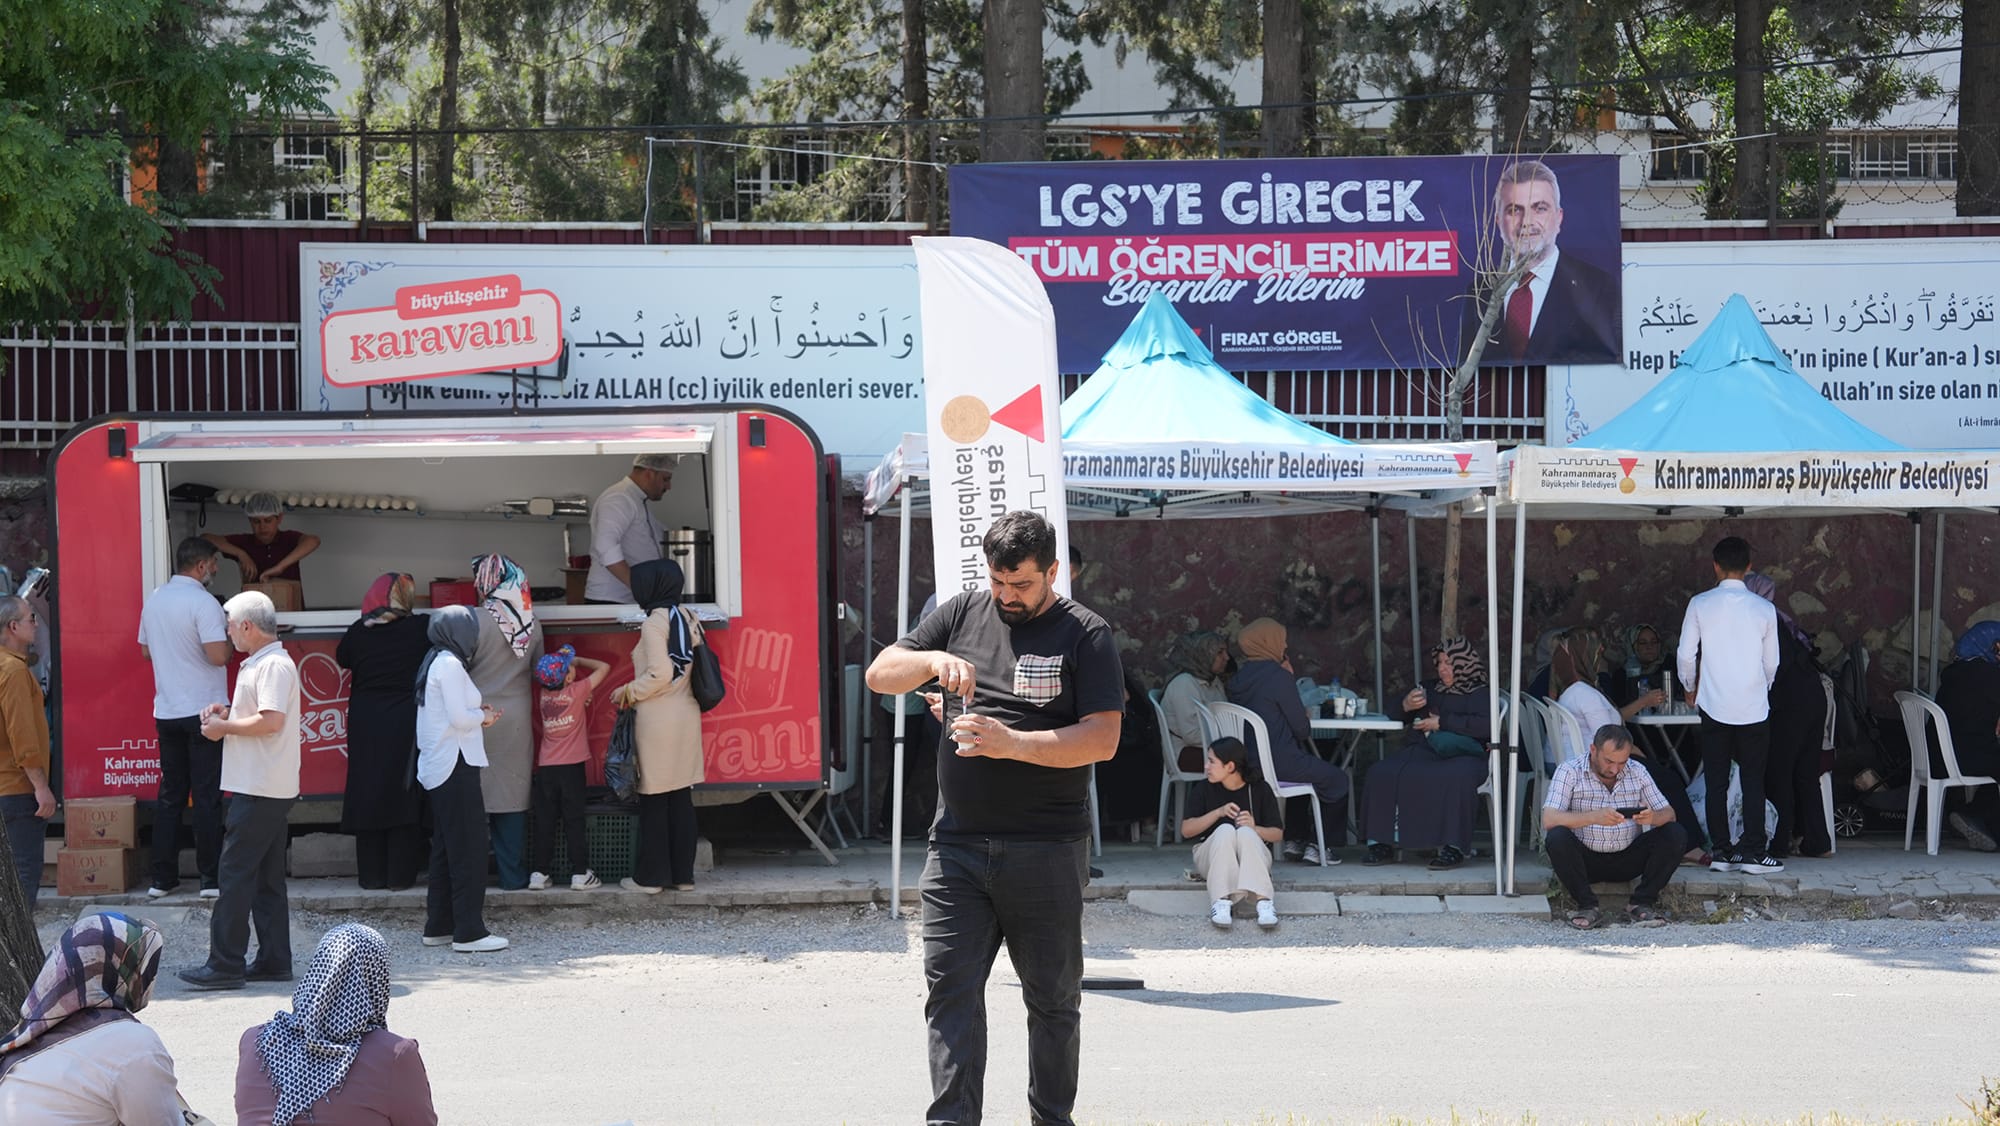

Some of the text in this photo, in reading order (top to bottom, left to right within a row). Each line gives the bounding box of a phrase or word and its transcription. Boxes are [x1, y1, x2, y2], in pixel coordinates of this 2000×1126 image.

[1040, 172, 1425, 227] LGS'YE GİRECEK
[1015, 237, 1451, 277] TÜM ÖĞRENCİLERİMİZE
[411, 284, 508, 310] büyükşehir
[1253, 267, 1366, 304] Dilerim
[350, 315, 537, 362] karavanı
[1221, 330, 1342, 346] FIRAT GÖRGEL
[1629, 350, 1664, 374] Hep
[1822, 348, 1868, 372] ipine
[1885, 347, 1967, 367] Kur'an-a
[595, 378, 662, 399] ALLAH
[668, 376, 707, 401] (cc)
[713, 377, 764, 403] iyilik
[769, 377, 853, 399] edenleri
[1821, 380, 1894, 401] Allah'ın
[1899, 380, 1936, 400] size
[1941, 380, 1981, 399] olan
[1278, 451, 1364, 481] Belediyesi
[1378, 463, 1453, 474] Kahramanmaraş
[1541, 468, 1617, 479] Kahramanmaraş
[1654, 458, 1989, 497] Kahramanmaraş Büyükşehir Belediyesi
[1541, 480, 1617, 489] Büyükşehir Belediyesi
[104, 756, 161, 770] Kahrama
[104, 771, 159, 788] Büyükşehir
